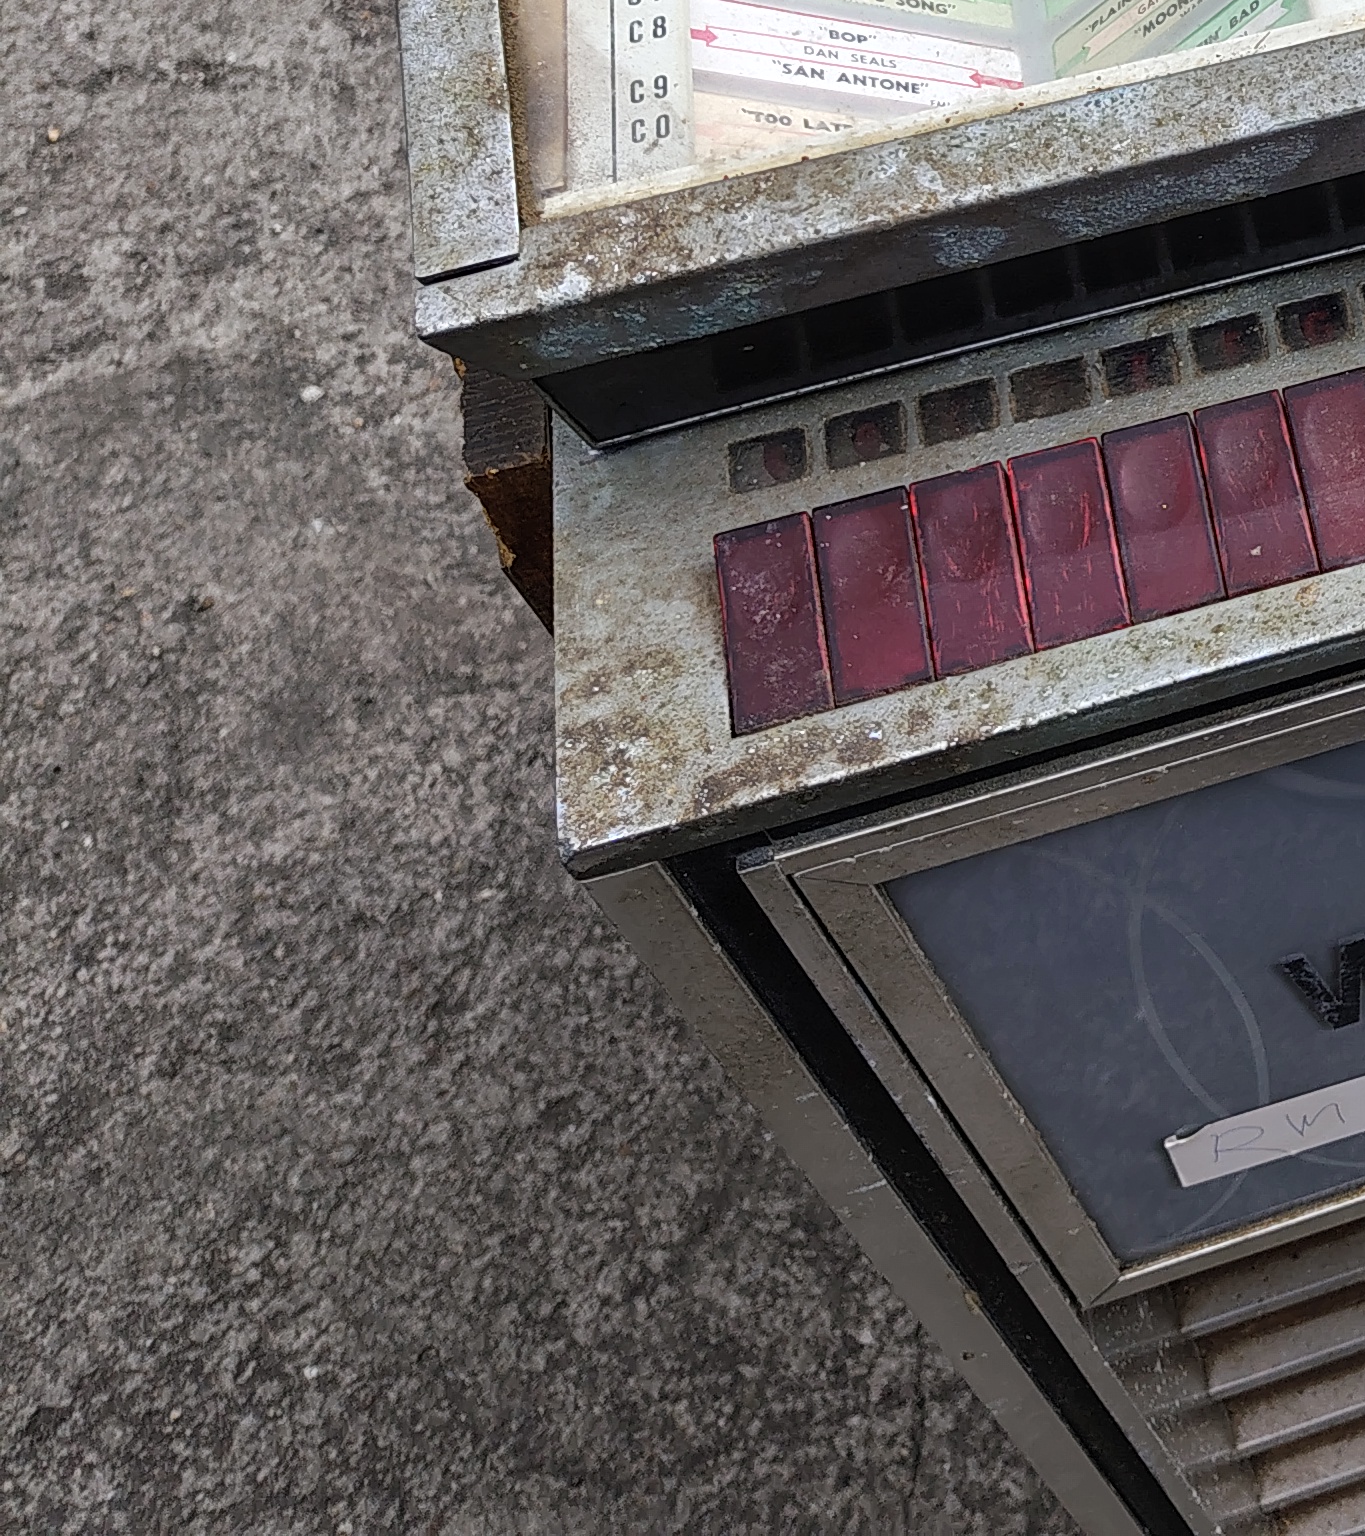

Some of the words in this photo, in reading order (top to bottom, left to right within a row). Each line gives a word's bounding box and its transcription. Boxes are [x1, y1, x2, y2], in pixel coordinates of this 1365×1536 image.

[819, 26, 878, 45] "BOP"
[803, 45, 839, 60] DAN
[851, 52, 897, 69] SEALS
[772, 59, 826, 81] "SAN
[836, 70, 929, 95] ANTONE"
